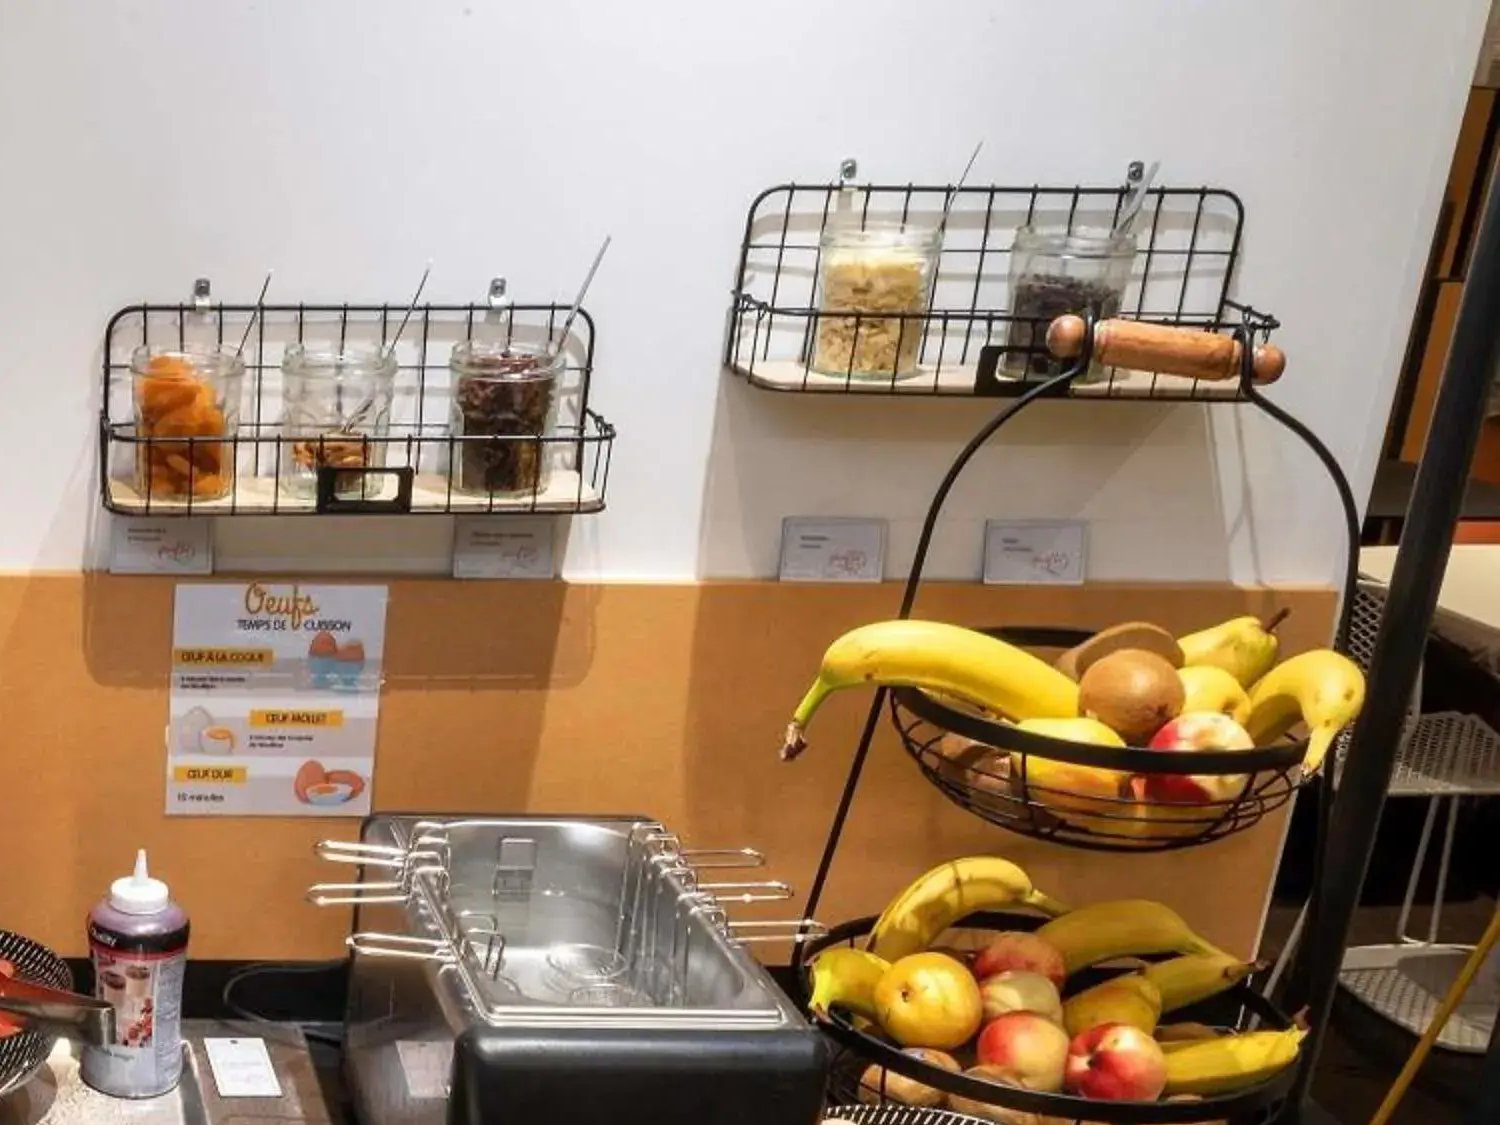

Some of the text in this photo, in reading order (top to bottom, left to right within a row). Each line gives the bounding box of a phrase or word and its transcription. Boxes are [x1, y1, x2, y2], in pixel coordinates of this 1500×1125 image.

[237, 619, 352, 632] TEMPS DE CUISSON
